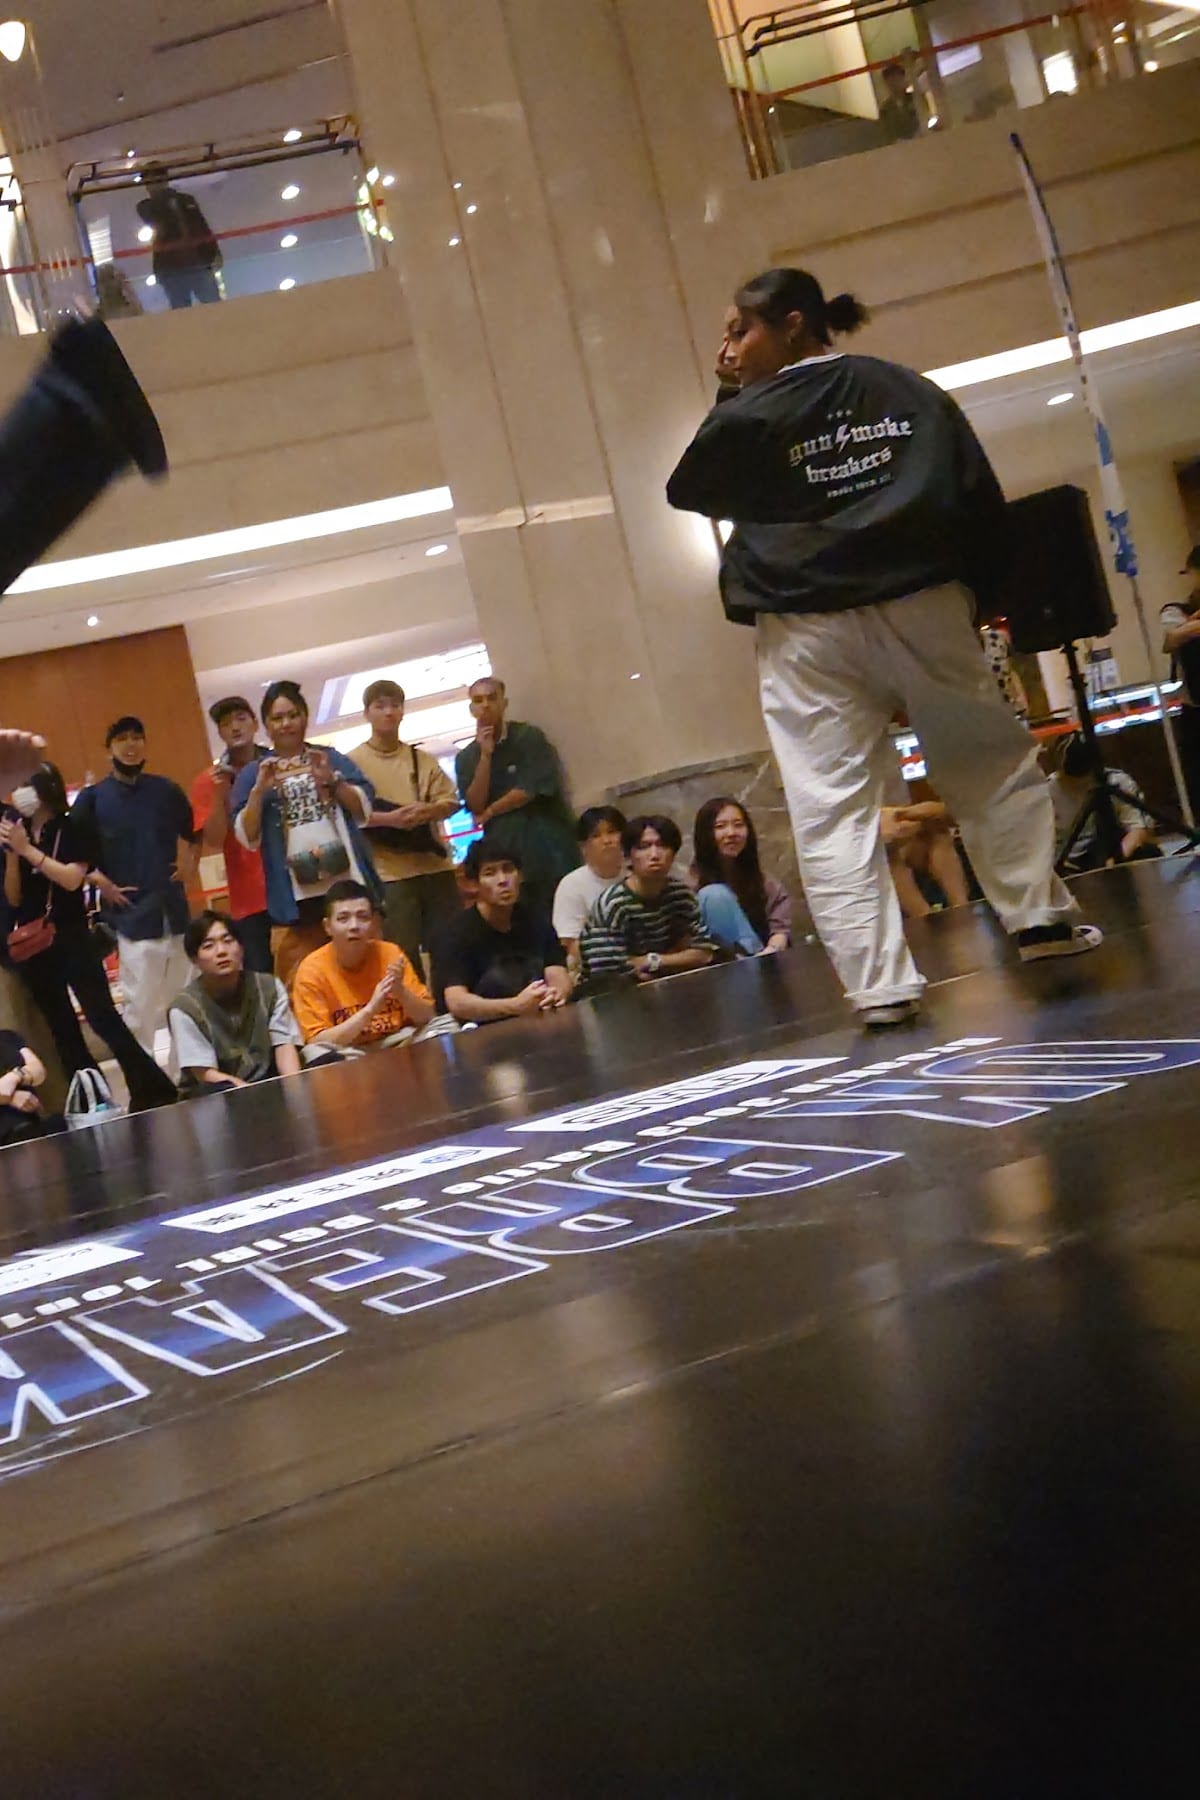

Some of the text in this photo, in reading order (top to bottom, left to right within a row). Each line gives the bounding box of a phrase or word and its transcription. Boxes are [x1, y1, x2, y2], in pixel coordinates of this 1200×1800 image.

[805, 446, 893, 483] breakers
[636, 1096, 790, 1137] 3on3
[441, 1140, 637, 1195] Battle
[175, 1214, 375, 1272] BGIRL
[0, 1276, 162, 1329] 1on1
